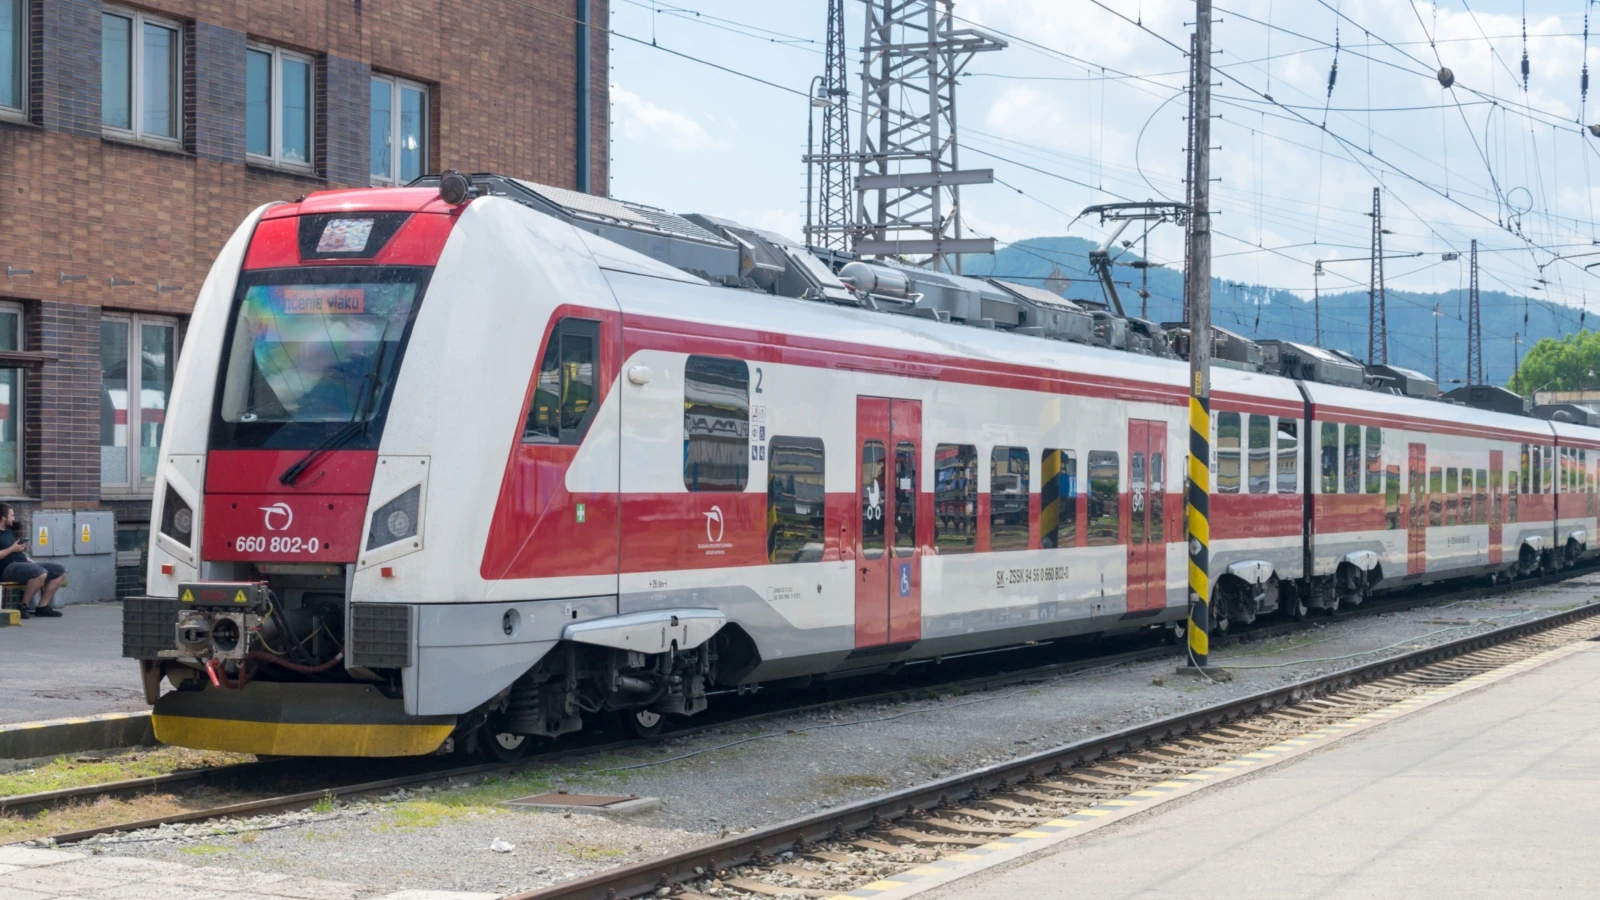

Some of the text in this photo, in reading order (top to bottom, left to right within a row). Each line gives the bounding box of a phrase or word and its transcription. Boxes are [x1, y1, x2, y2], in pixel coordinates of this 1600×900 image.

[327, 294, 359, 310] vlaku
[755, 367, 763, 394] 2
[235, 536, 319, 553] 660 802-0
[996, 570, 1005, 585] SK
[1009, 569, 1024, 584] ZSSK
[1025, 569, 1031, 582] 94
[1033, 568, 1039, 582] 56
[1045, 567, 1054, 581] 660
[1055, 566, 1069, 580] 802-0
